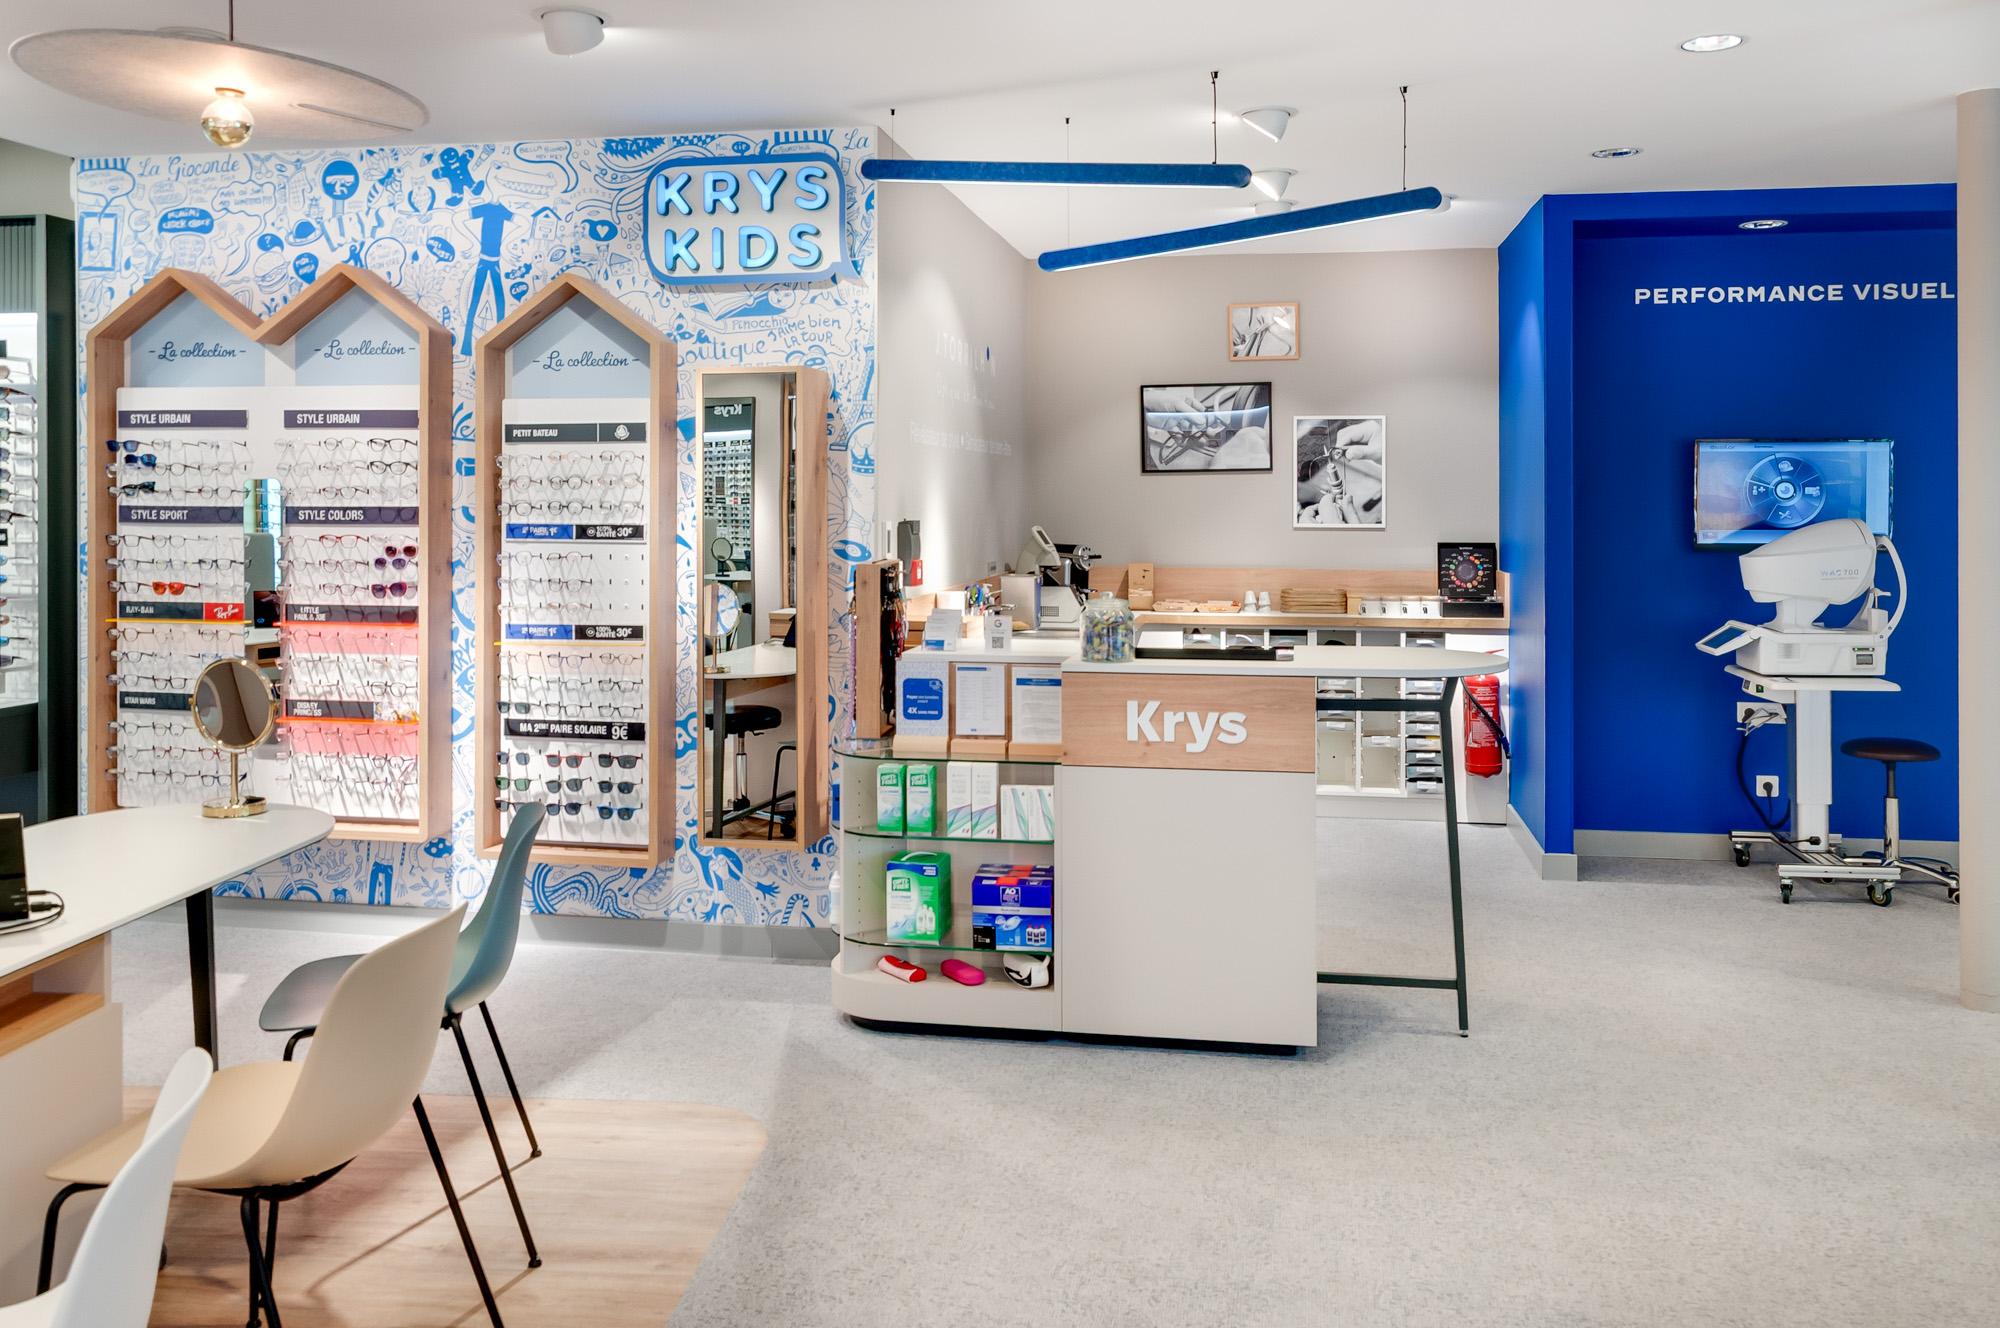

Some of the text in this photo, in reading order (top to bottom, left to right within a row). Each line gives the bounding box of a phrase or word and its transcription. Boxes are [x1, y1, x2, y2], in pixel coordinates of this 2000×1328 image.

[137, 157, 161, 178] La
[167, 153, 241, 182] Gioconde
[656, 164, 831, 216] KRYS
[664, 223, 823, 272] KIDS
[1634, 284, 1844, 305] PERFORMANCE
[731, 315, 789, 331] Pinocchio
[808, 313, 841, 330] bien
[157, 339, 236, 360] La collection
[323, 338, 406, 360] La collection
[542, 349, 630, 372] La collection
[130, 413, 191, 425] STYLE URBAIN
[296, 413, 360, 425] STYLE URBAIN
[512, 428, 558, 438] PETIT BATEAU
[131, 509, 188, 522] STYLE SPORT
[298, 510, 364, 522] STYLE COLORS
[124, 696, 156, 705] STAR WARS
[519, 722, 532, 733] MA
[550, 723, 573, 734] PAIRE
[574, 725, 607, 735] SOLAIRE
[611, 726, 629, 740] 9€
[1126, 700, 1248, 752] Krys
